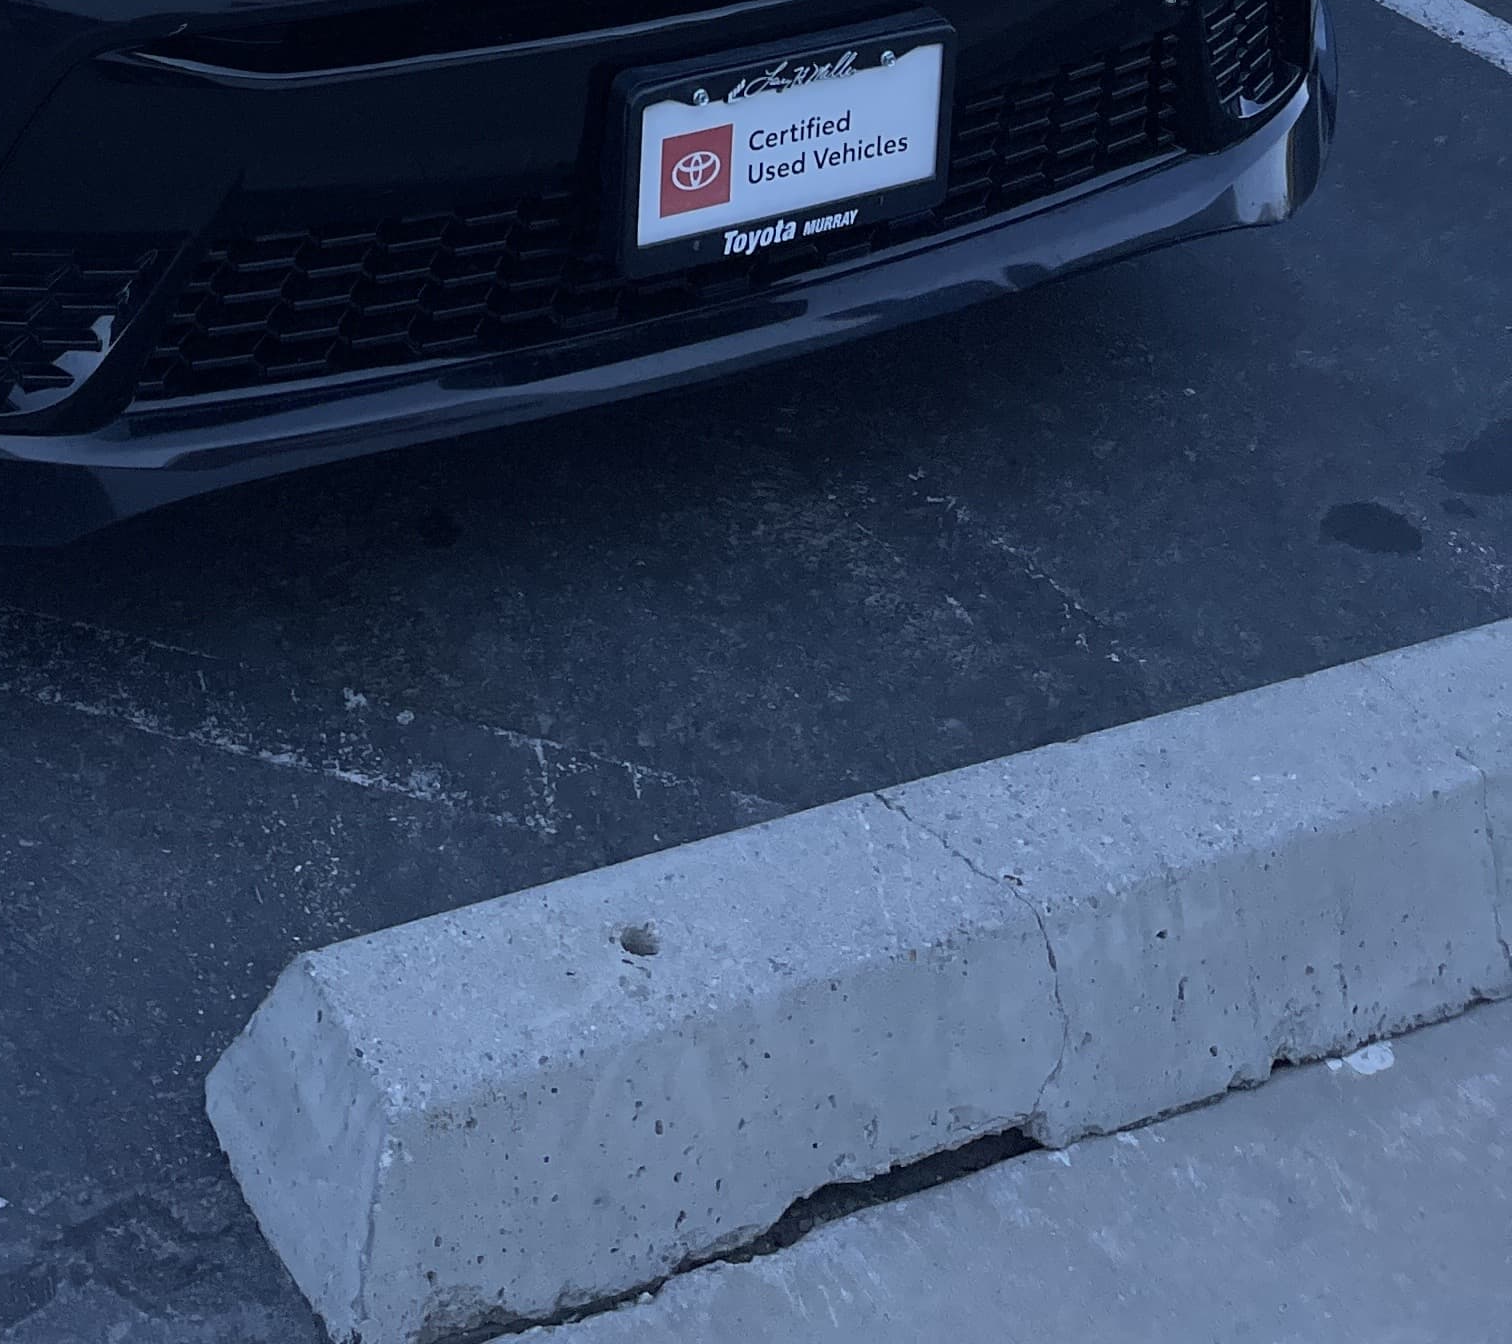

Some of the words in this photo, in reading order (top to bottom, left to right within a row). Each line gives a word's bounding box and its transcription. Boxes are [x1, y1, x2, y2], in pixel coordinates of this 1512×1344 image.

[748, 109, 851, 151] Certified
[747, 151, 806, 184] Used
[813, 125, 909, 169] Vehicles
[723, 218, 797, 255] Toyota
[802, 209, 859, 237] MURRAY
